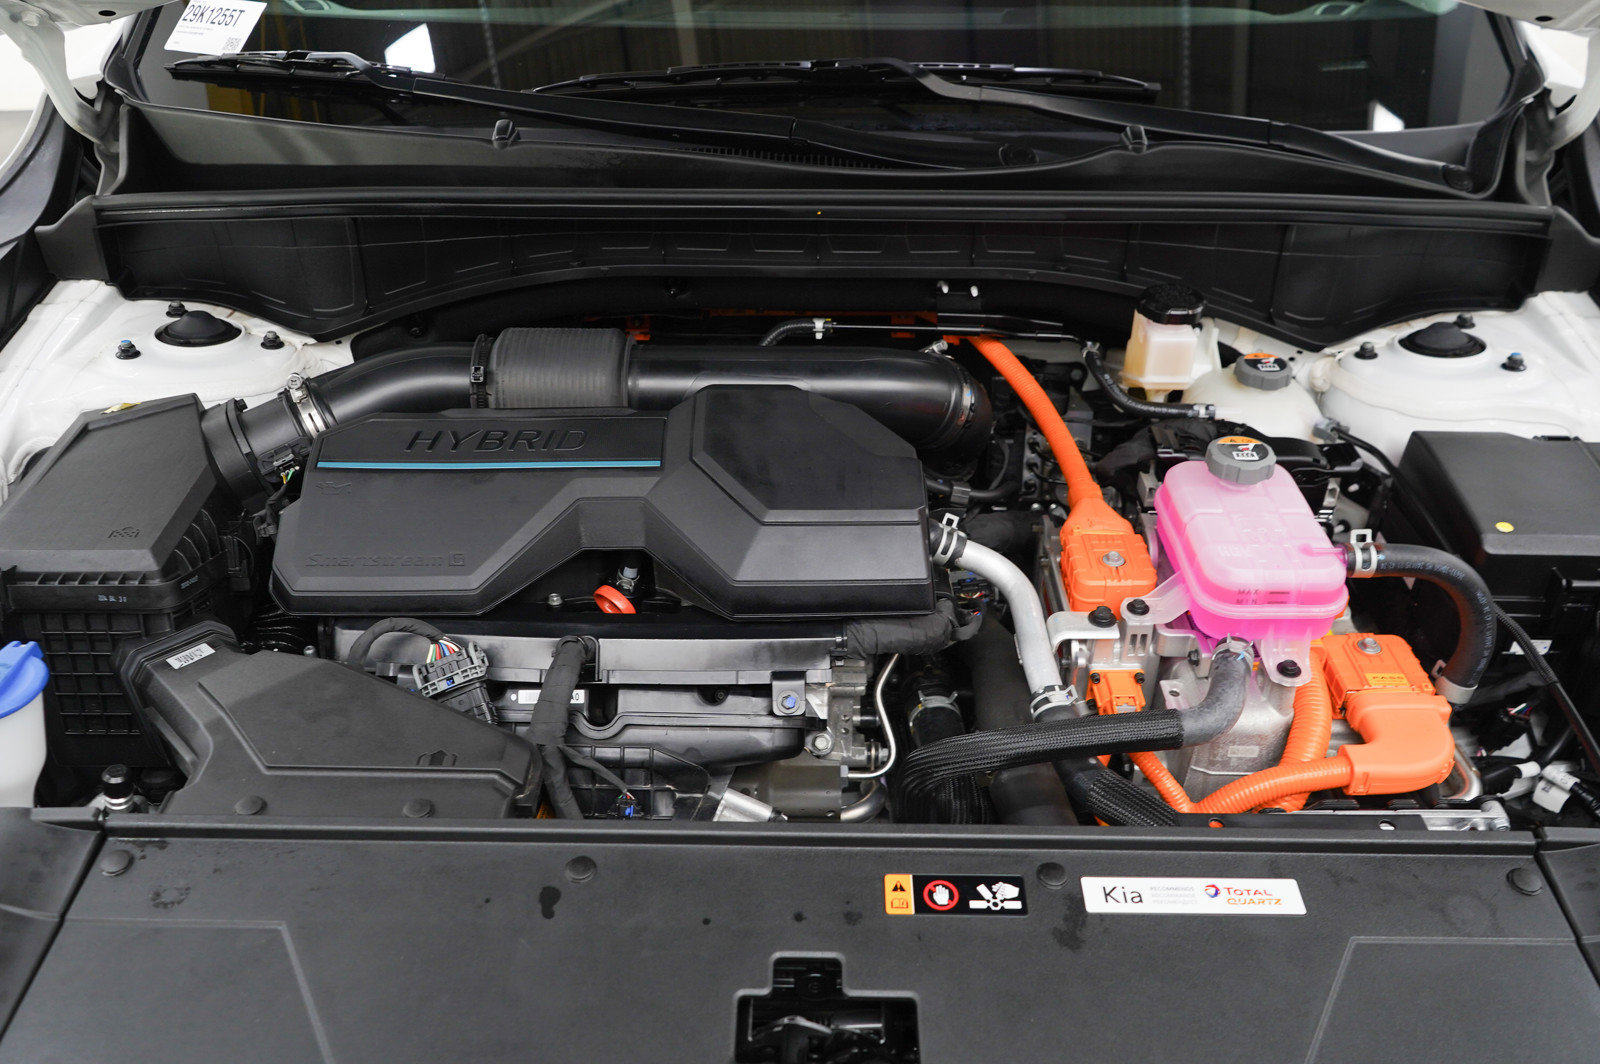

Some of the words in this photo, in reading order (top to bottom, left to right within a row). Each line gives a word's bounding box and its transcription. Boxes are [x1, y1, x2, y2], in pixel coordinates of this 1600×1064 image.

[182, 4, 245, 27] 29K1255T
[403, 429, 588, 453] HYBRID
[305, 553, 443, 568] Smartstream
[1102, 885, 1144, 904] Kia
[1223, 886, 1273, 897] TOTAL
[1226, 897, 1283, 906] QUARTZ
